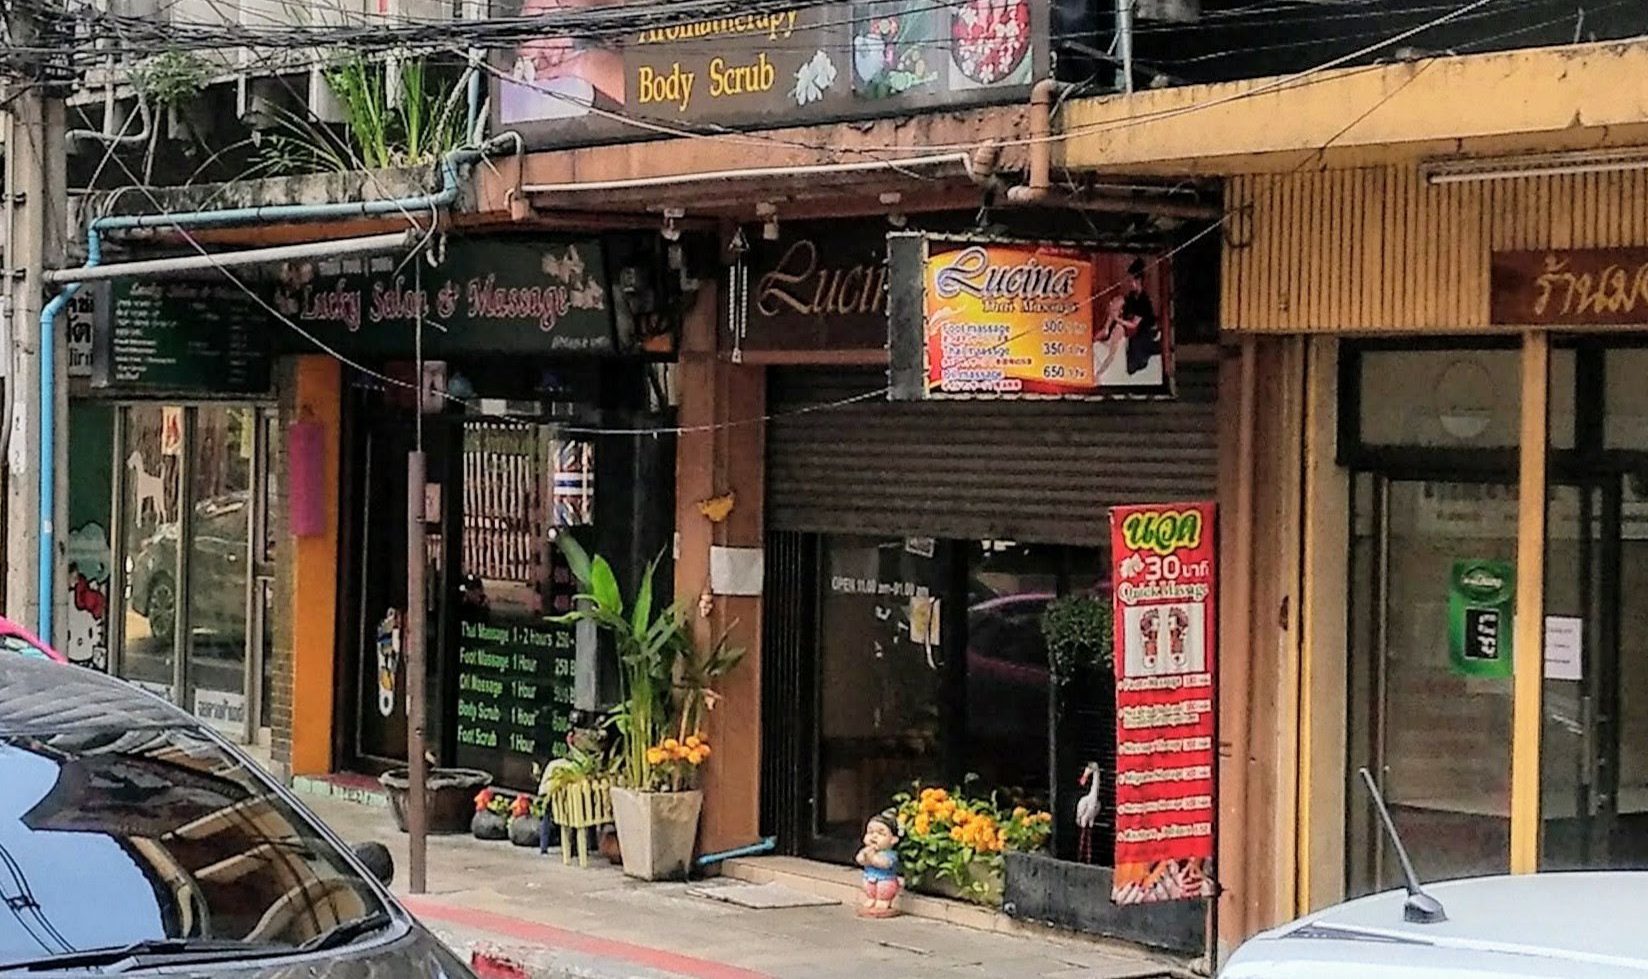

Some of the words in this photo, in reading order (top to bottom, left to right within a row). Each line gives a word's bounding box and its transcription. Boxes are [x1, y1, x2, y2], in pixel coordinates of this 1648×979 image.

[639, 63, 695, 112] Body
[710, 52, 775, 97] Scrub
[935, 246, 1079, 301] Lucina
[301, 278, 361, 331] Lucky
[369, 275, 428, 322] Salon
[438, 280, 459, 319] &
[468, 273, 571, 331] Massage
[832, 576, 855, 593] OPEN
[1144, 555, 1180, 581] 30
